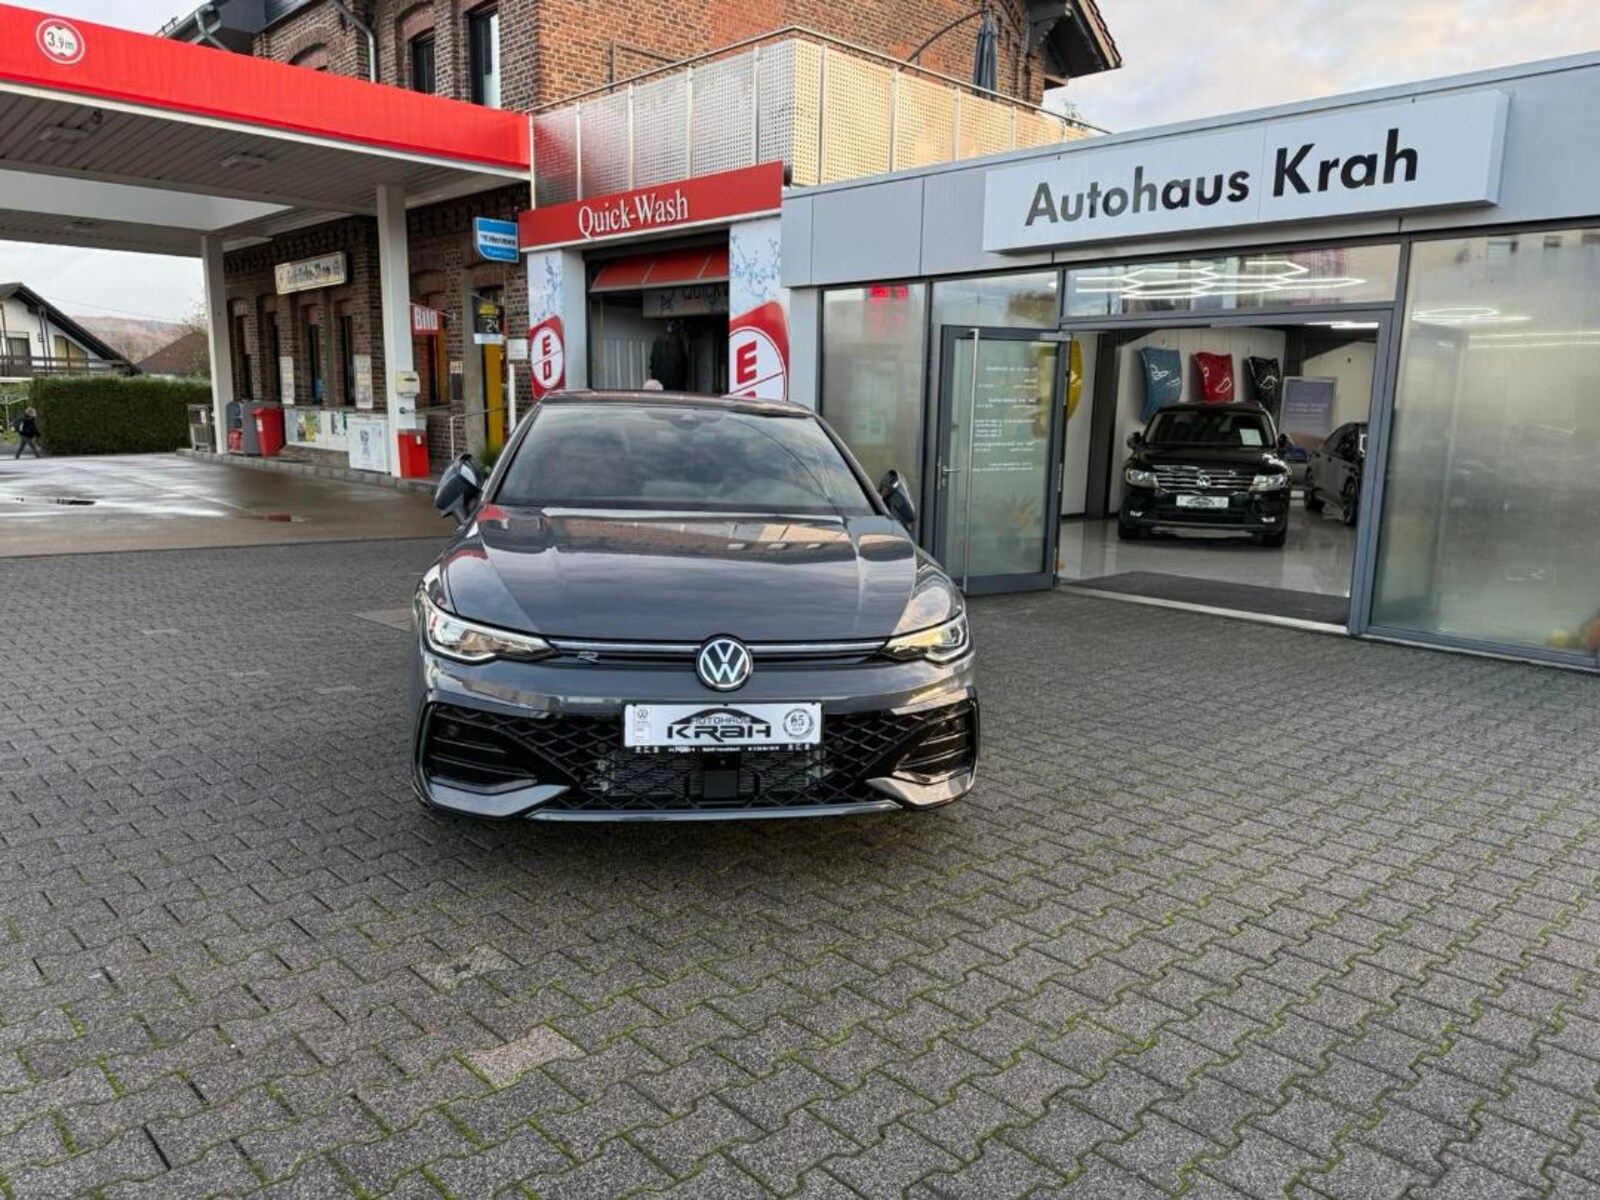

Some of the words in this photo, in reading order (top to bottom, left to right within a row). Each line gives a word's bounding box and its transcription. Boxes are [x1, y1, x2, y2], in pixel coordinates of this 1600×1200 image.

[1025, 166, 1250, 226] Autohaus
[1273, 128, 1418, 197] Krah
[578, 189, 689, 240] Quick-Wash
